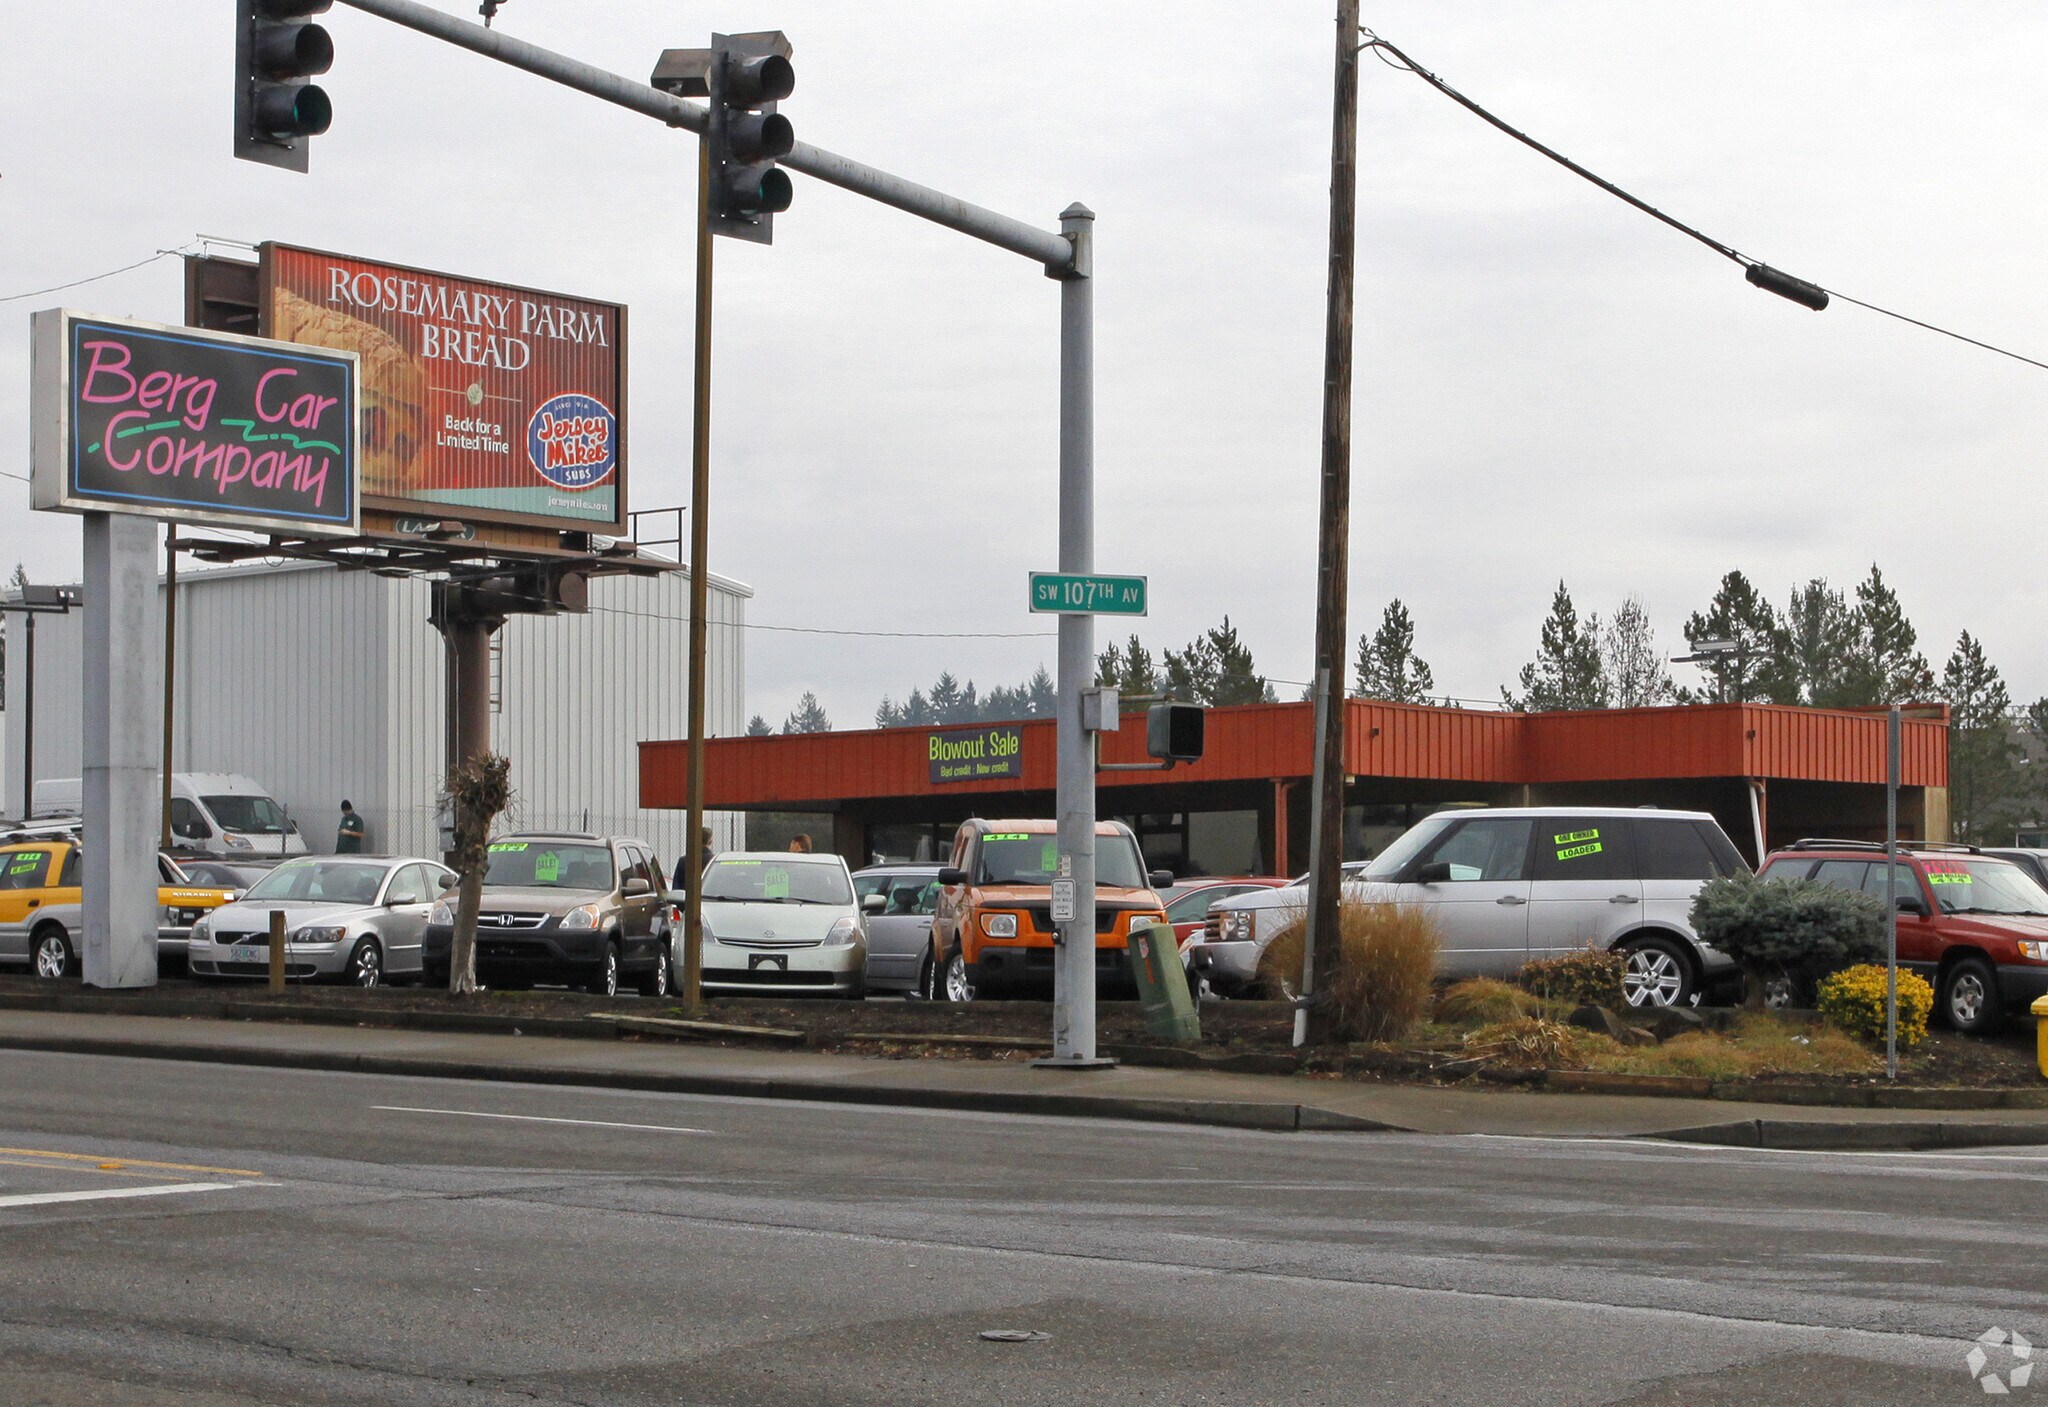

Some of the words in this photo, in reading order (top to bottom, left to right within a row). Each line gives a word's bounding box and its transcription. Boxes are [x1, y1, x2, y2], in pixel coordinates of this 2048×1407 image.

[327, 267, 514, 330] ROSEMARY
[520, 300, 609, 347] PARM
[421, 322, 530, 371] BREAD
[81, 340, 218, 431] Berg
[255, 368, 338, 430] Car
[445, 414, 474, 432] Back
[475, 418, 491, 434] for
[493, 424, 501, 436] a
[538, 412, 608, 444] Jersey
[437, 431, 480, 450] Limited
[481, 437, 509, 454] Time
[105, 410, 329, 508] Company
[565, 468, 592, 481] SUBS
[1038, 584, 1058, 600] SW
[1063, 580, 1114, 606] 107TH
[1122, 588, 1138, 603] AV
[929, 735, 985, 761] Blowout
[989, 731, 1019, 756] Sale
[954, 764, 971, 776] credit
[991, 761, 1009, 773] credit
[1563, 844, 1596, 858] LOADED
